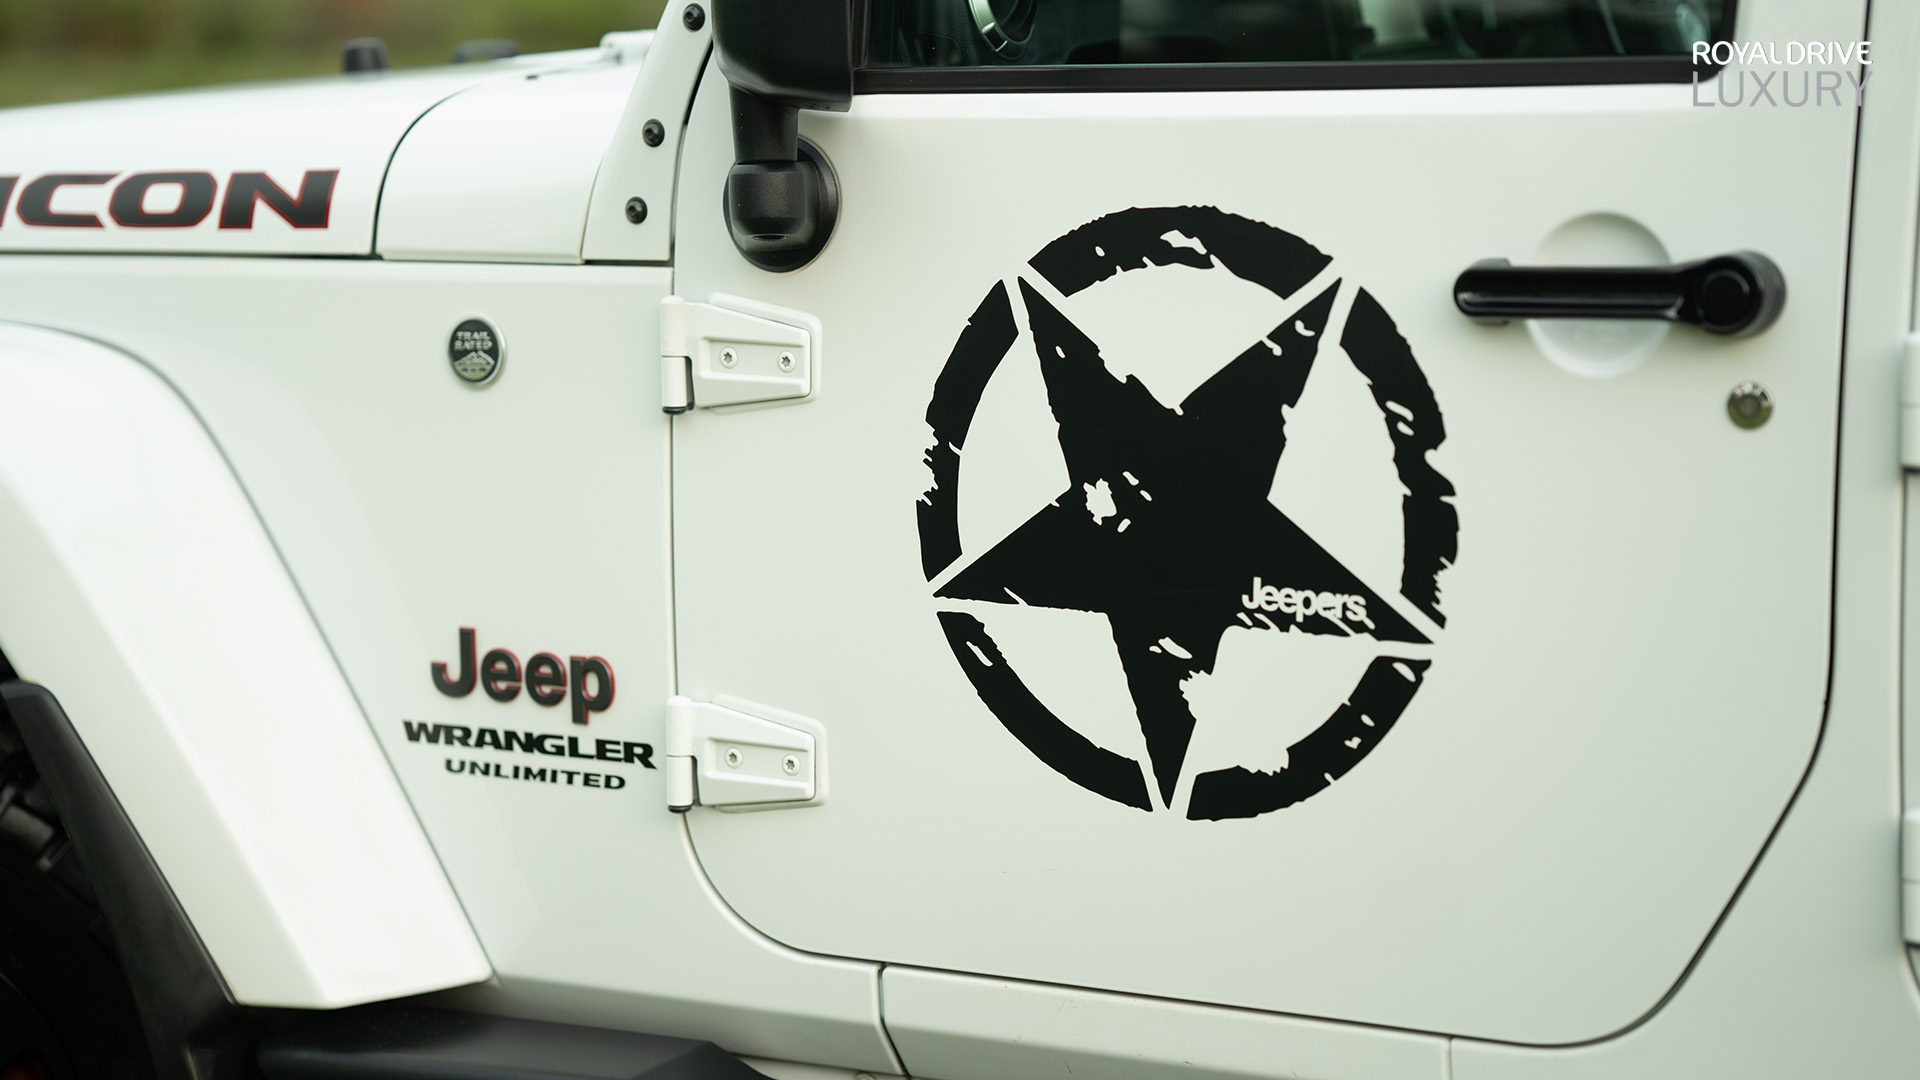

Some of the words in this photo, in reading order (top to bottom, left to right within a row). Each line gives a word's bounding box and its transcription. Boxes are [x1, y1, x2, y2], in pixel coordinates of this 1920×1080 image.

[454, 340, 494, 351] RATED
[456, 331, 492, 341] TRAIL
[1241, 576, 1368, 623] Jeepers
[431, 626, 616, 726] Jeep
[403, 719, 658, 770] WRANGLER
[444, 758, 627, 790] UNLIMITED
